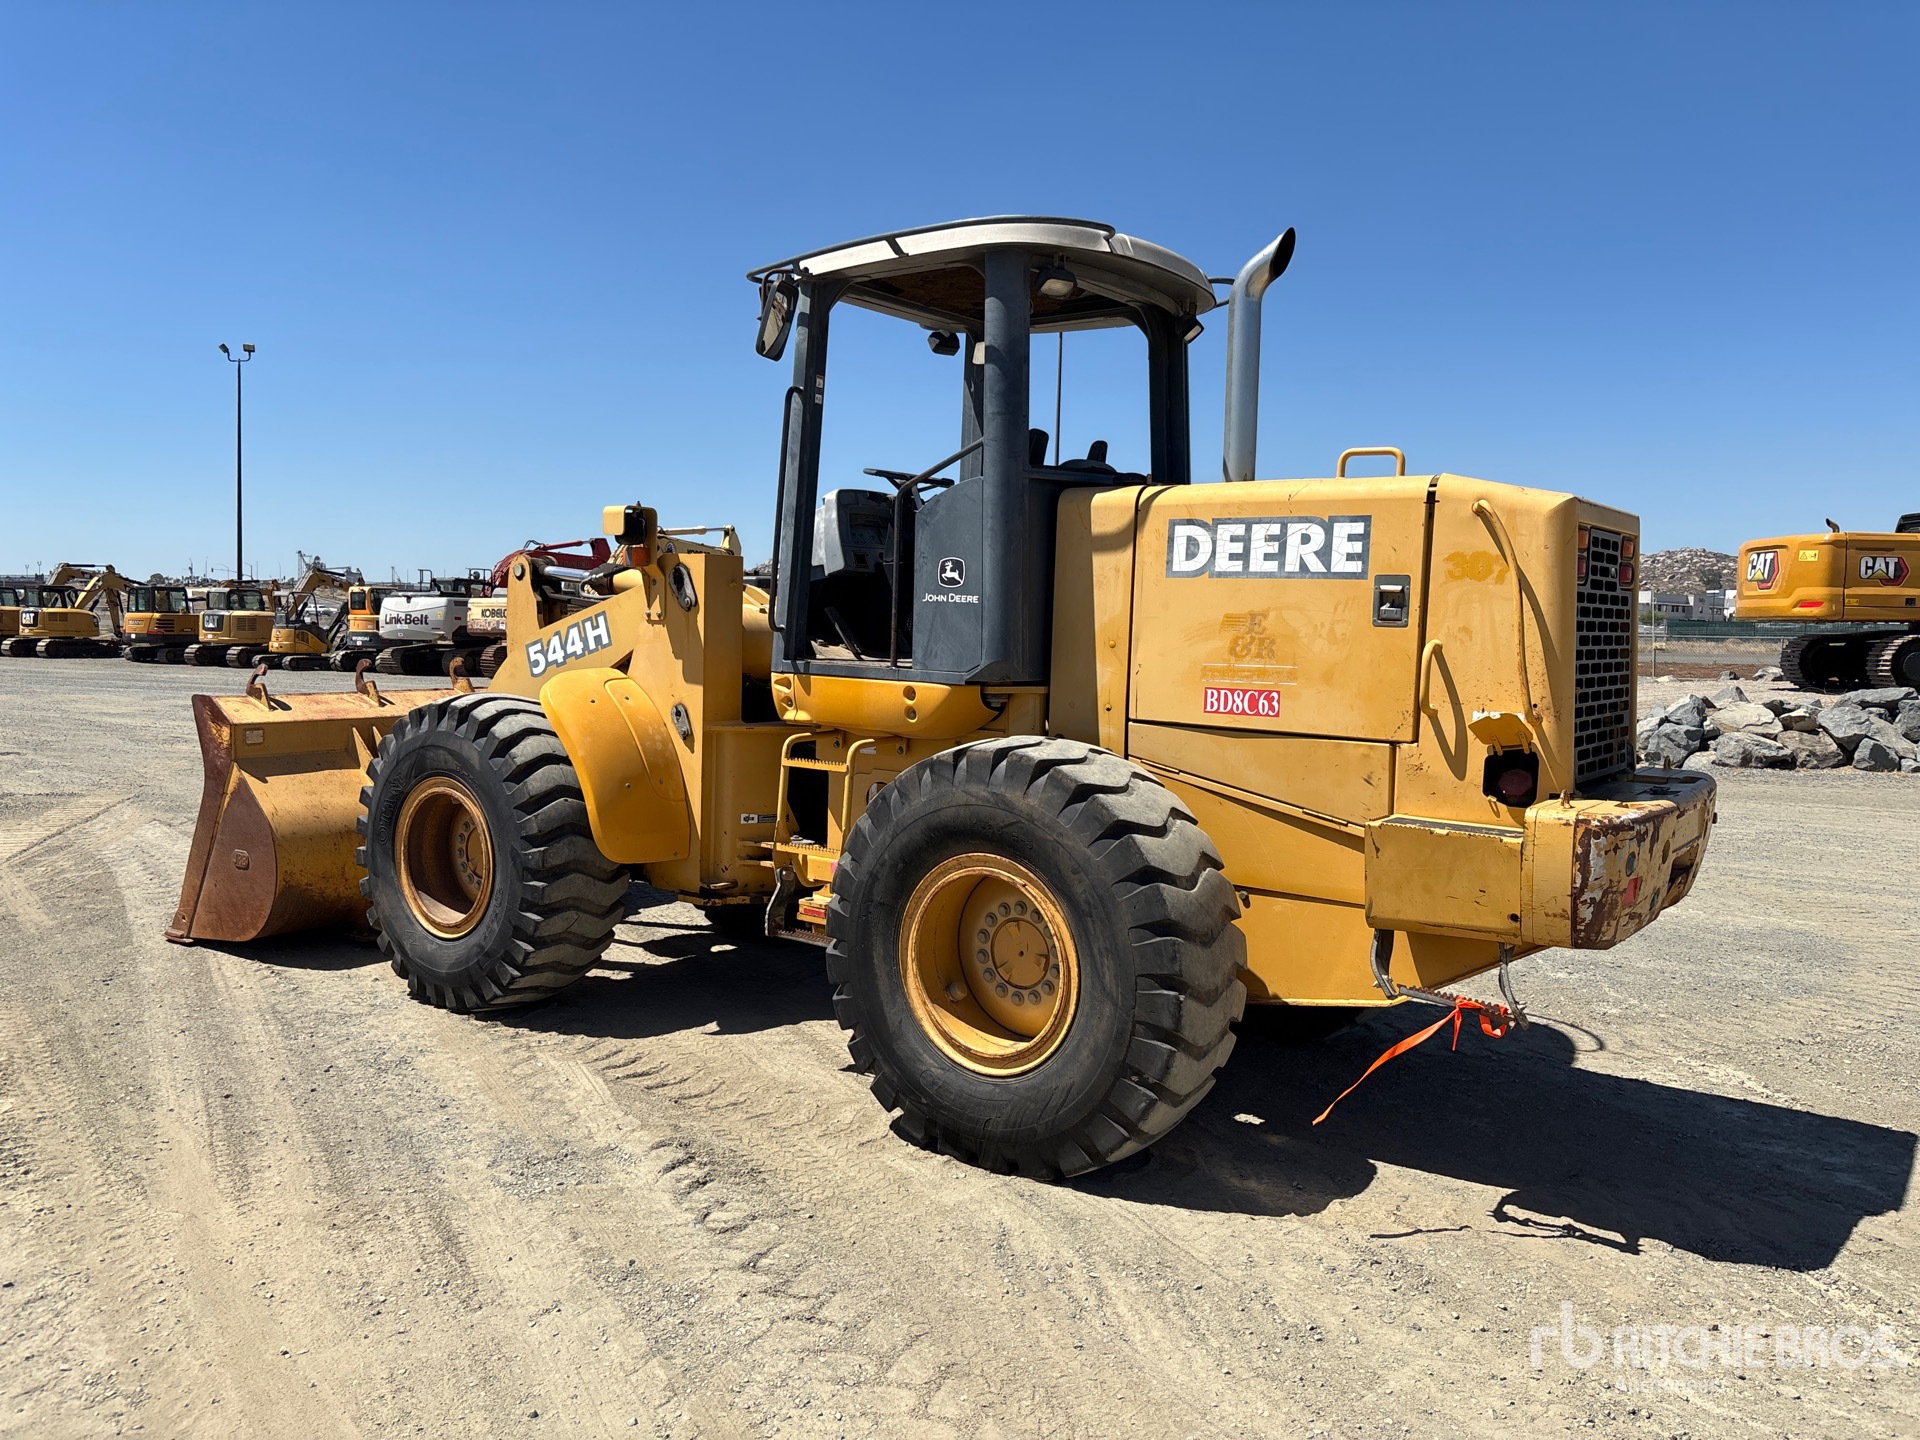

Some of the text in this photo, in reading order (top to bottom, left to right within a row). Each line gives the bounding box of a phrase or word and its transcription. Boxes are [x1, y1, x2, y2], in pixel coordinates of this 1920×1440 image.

[1171, 521, 1366, 574] DEERE
[1747, 552, 1773, 580] CAT
[1860, 556, 1899, 580] CAT
[922, 592, 979, 603] JOHN DEERE
[21, 612, 35, 625] CAT
[204, 614, 220, 628] CAT
[384, 613, 429, 625] Link-Belt
[528, 615, 610, 675] 544H
[1204, 688, 1280, 716] BD8C63
